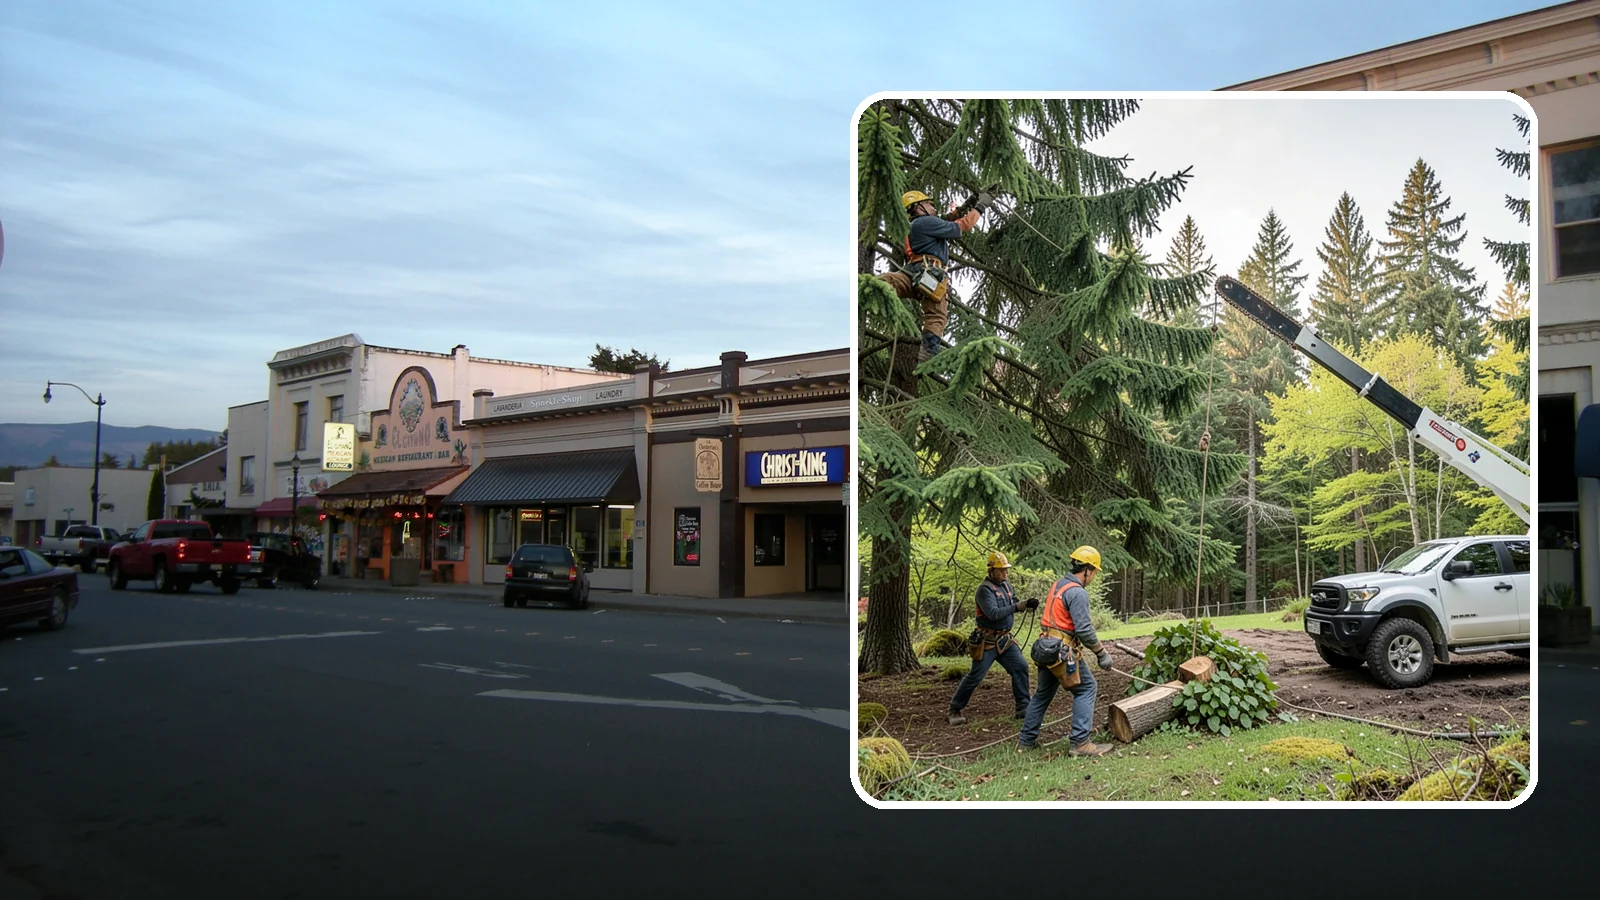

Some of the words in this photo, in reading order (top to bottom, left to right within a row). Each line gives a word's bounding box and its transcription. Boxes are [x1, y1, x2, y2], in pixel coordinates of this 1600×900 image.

[562, 394, 582, 405] Shop
[595, 389, 623, 400] LAUNDRY
[493, 402, 522, 413] LAVANDERIA
[373, 454, 396, 464] MEXICAN
[397, 451, 433, 462] RESTAURANT
[437, 450, 450, 459] BAR
[761, 452, 797, 478] CHRIST
[799, 450, 828, 476] KING
